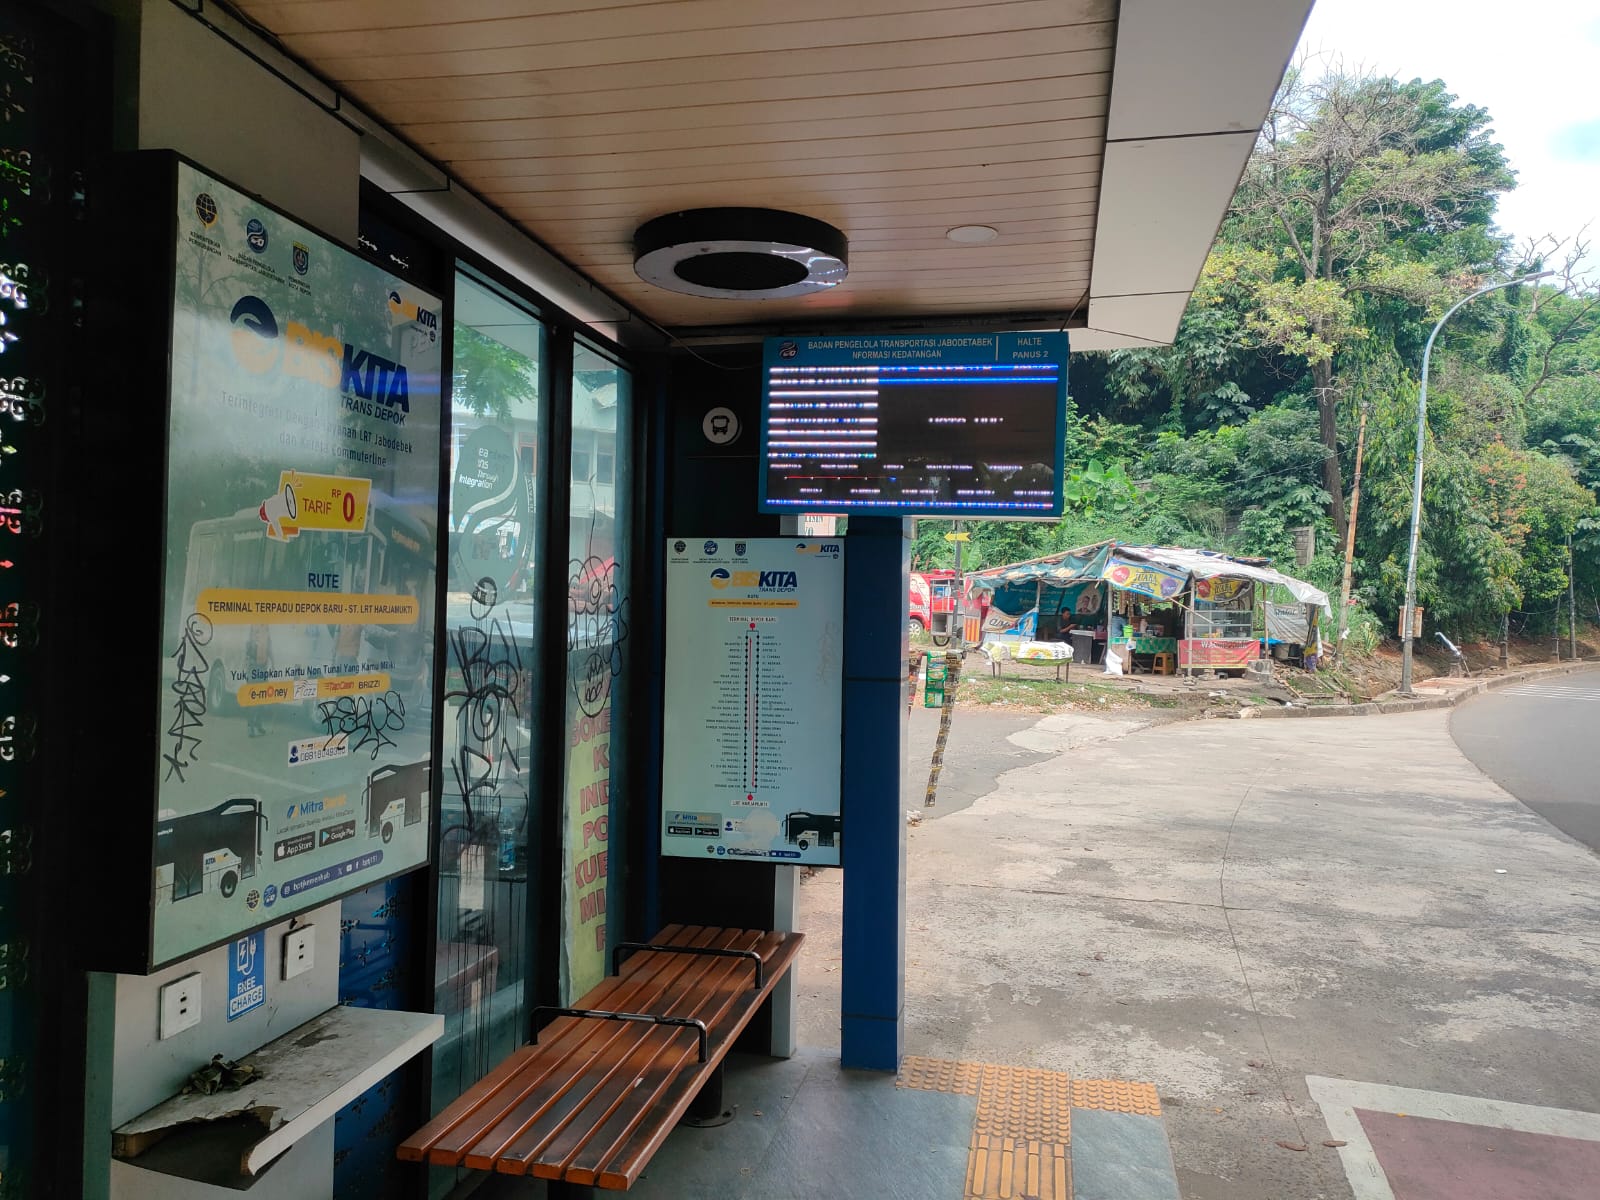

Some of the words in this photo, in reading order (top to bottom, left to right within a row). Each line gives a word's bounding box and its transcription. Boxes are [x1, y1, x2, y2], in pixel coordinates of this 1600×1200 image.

[808, 341, 830, 350] BADAN
[831, 341, 879, 349] PENGELOLA
[880, 339, 936, 348] TRANSPORTASI
[937, 338, 993, 347] JABODETABEK
[1018, 337, 1042, 346] HALTE
[892, 350, 942, 359] KEDATANGAN
[1013, 351, 1041, 359] PANUS
[1043, 350, 1049, 358] 2
[341, 395, 373, 419] TRANS
[374, 403, 407, 426] DEPOK
[279, 430, 297, 448] dan
[359, 427, 372, 443] LRT
[373, 429, 413, 455] Jabodebek
[459, 473, 493, 489] Integration
[303, 497, 333, 517] TARIF
[331, 488, 342, 500] RP
[308, 572, 340, 589] RUTE
[1135, 571, 1158, 585] JUARA
[208, 601, 253, 613] TERMINAL
[256, 602, 295, 614] TERPADU
[296, 602, 321, 614] DEPOK
[323, 602, 343, 614] BARU
[349, 604, 359, 615] ST.
[360, 605, 372, 615] LRT
[374, 605, 413, 615] HARJAMUKTI
[231, 670, 247, 682] Yuk,
[251, 667, 283, 682] Siapkan
[285, 666, 305, 678] Kartu
[307, 665, 321, 677] Non
[324, 664, 342, 675] Tunai
[344, 663, 360, 675] Yang
[359, 680, 381, 690] BRIZZI
[287, 844, 298, 856] App
[298, 841, 313, 852] Store
[231, 988, 262, 1013] CHARGE
